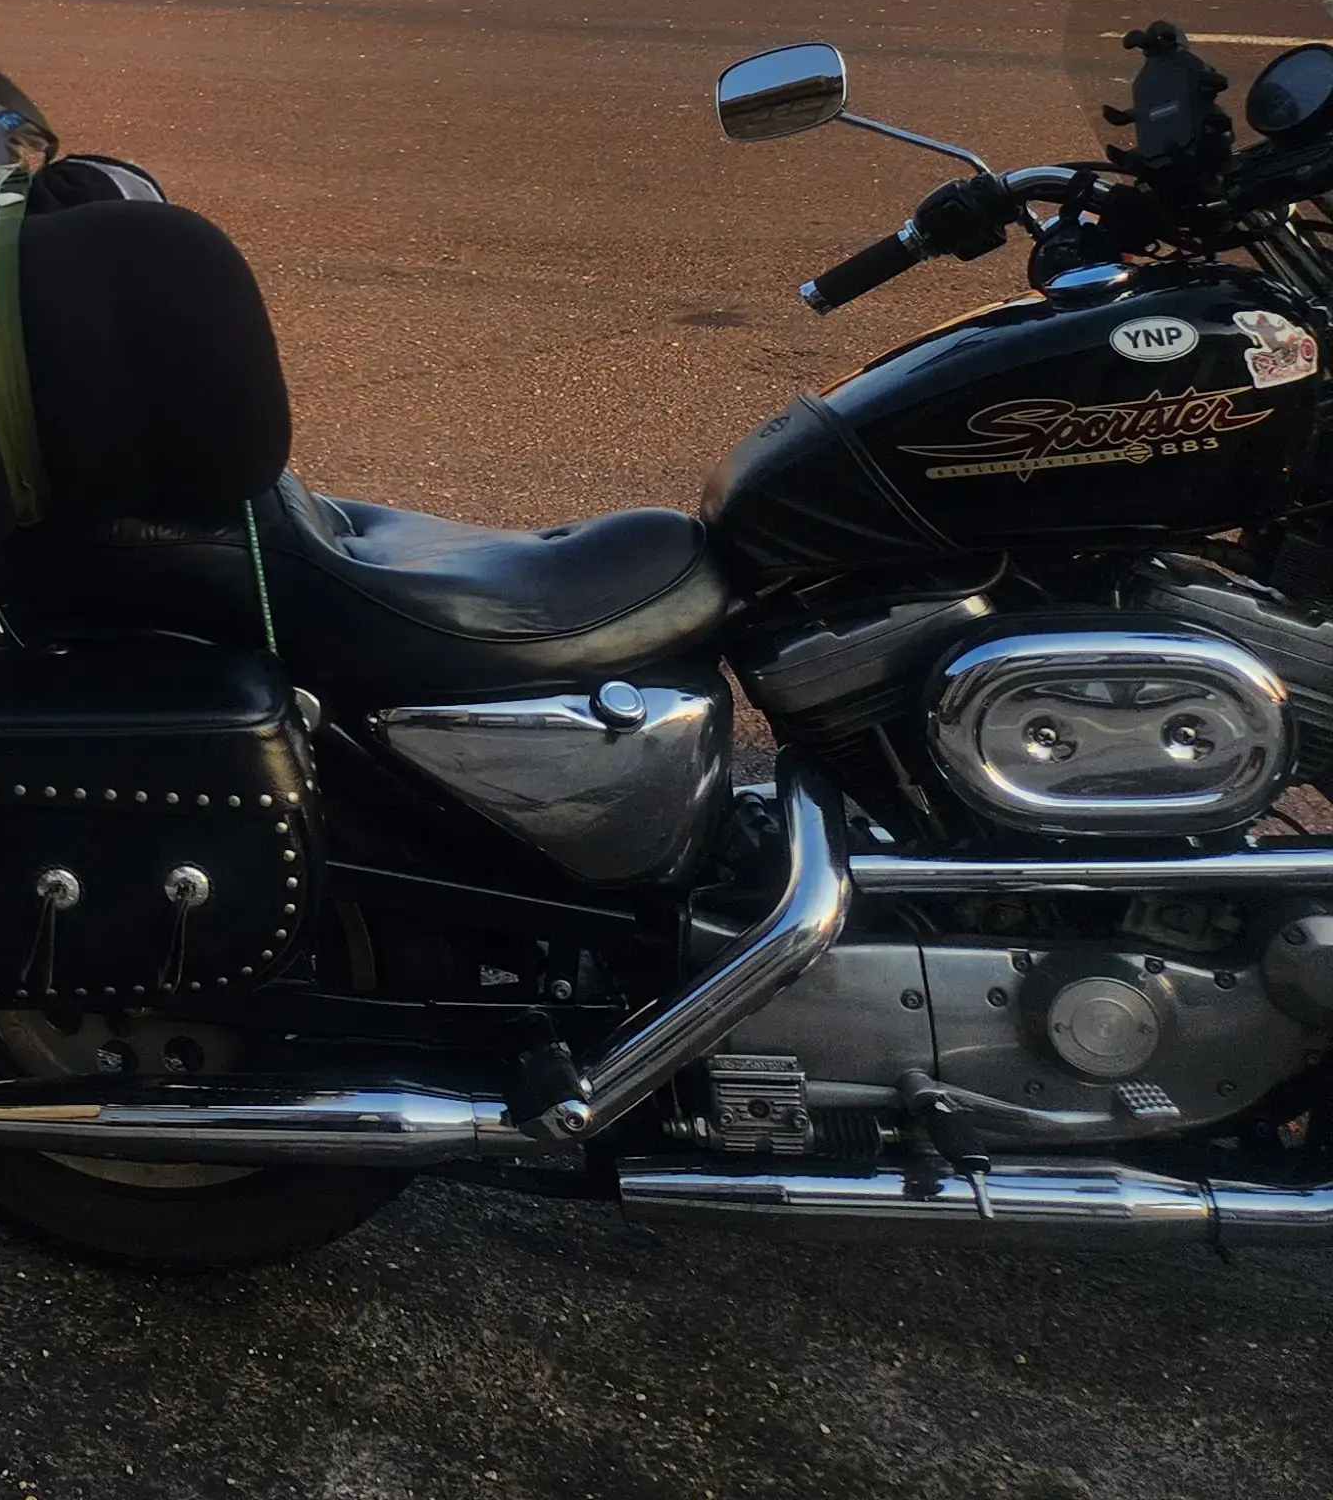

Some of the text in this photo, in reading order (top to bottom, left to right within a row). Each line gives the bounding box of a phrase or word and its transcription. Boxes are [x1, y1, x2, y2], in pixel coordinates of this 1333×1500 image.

[1122, 326, 1183, 349] YNP
[897, 386, 1275, 482] Sportster
[1160, 437, 1220, 456] 883
